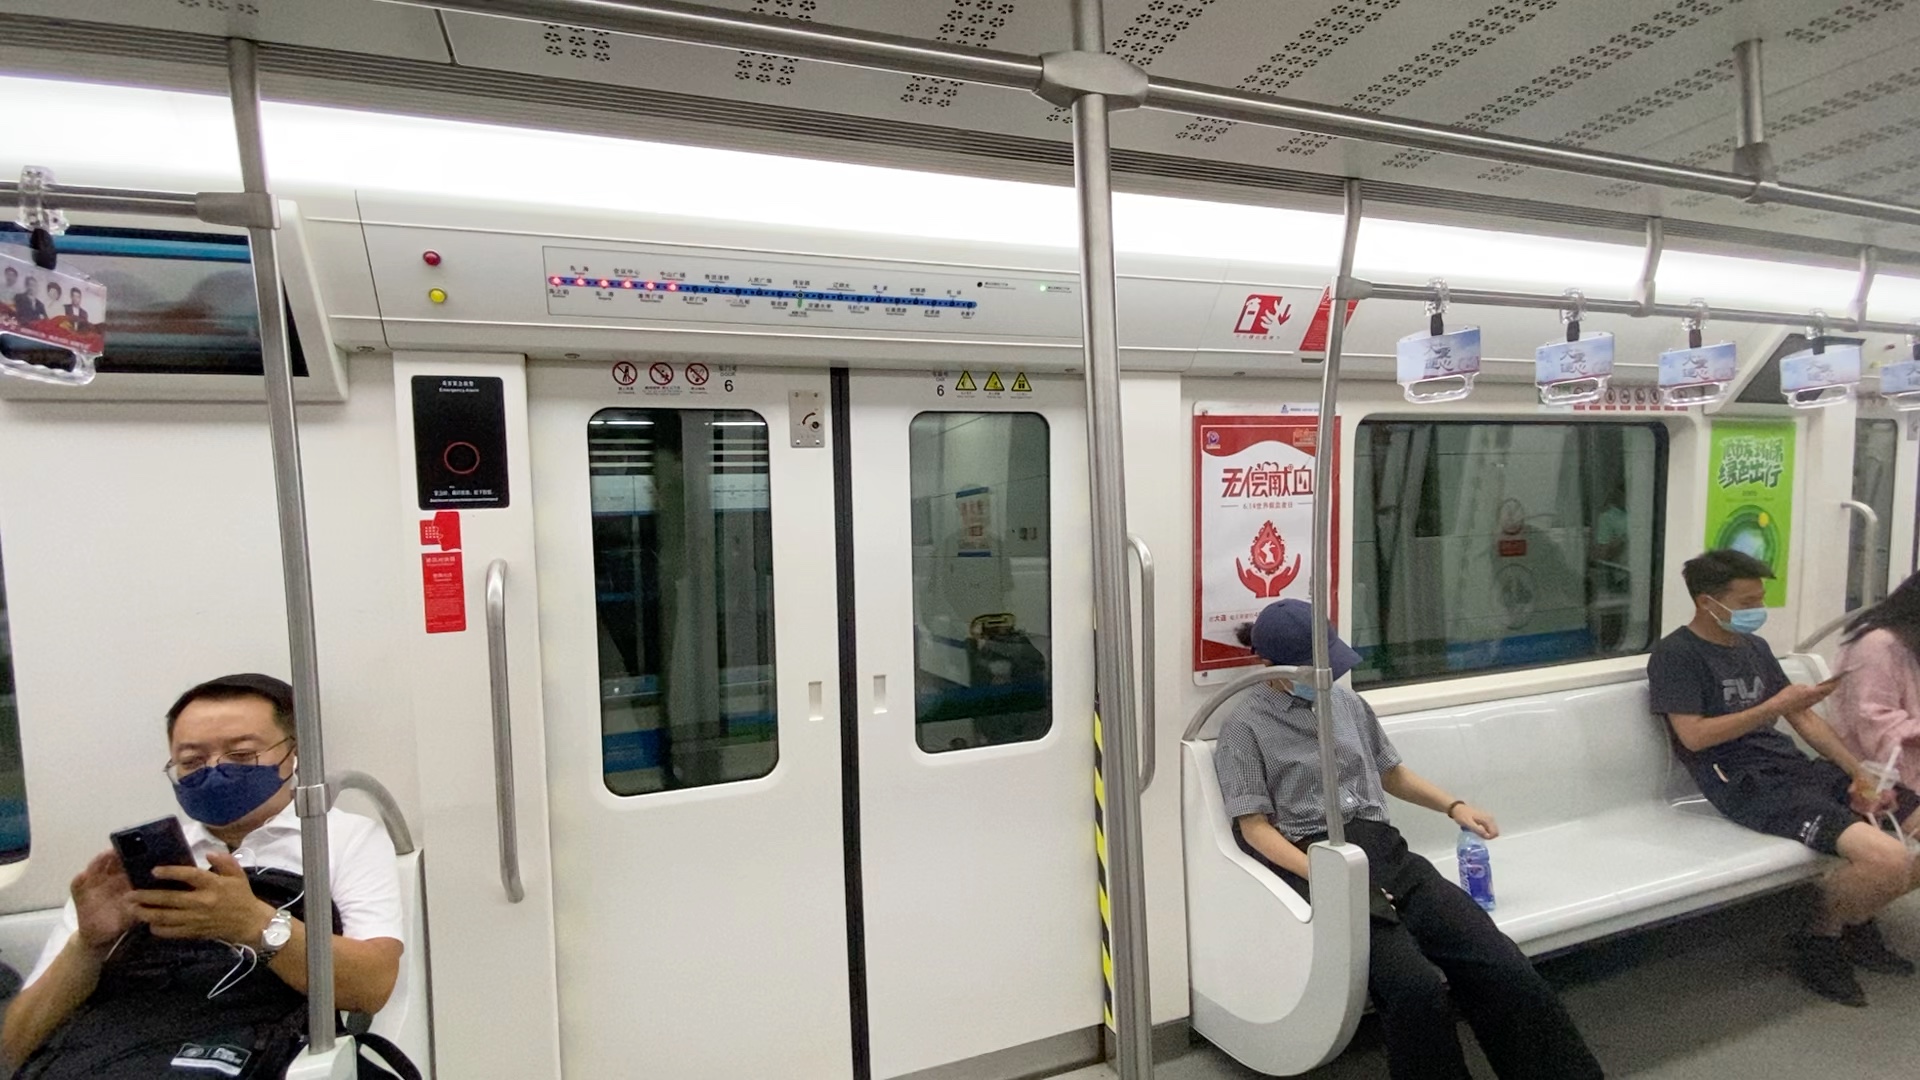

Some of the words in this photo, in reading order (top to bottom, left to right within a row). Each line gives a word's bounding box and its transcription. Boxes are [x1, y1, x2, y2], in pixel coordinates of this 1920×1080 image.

[724, 379, 734, 392] 6
[937, 384, 945, 397] 6
[1221, 463, 1314, 498] 无偿献血
[1718, 459, 1783, 489] 绿色出行
[1722, 676, 1766, 701] FILA
